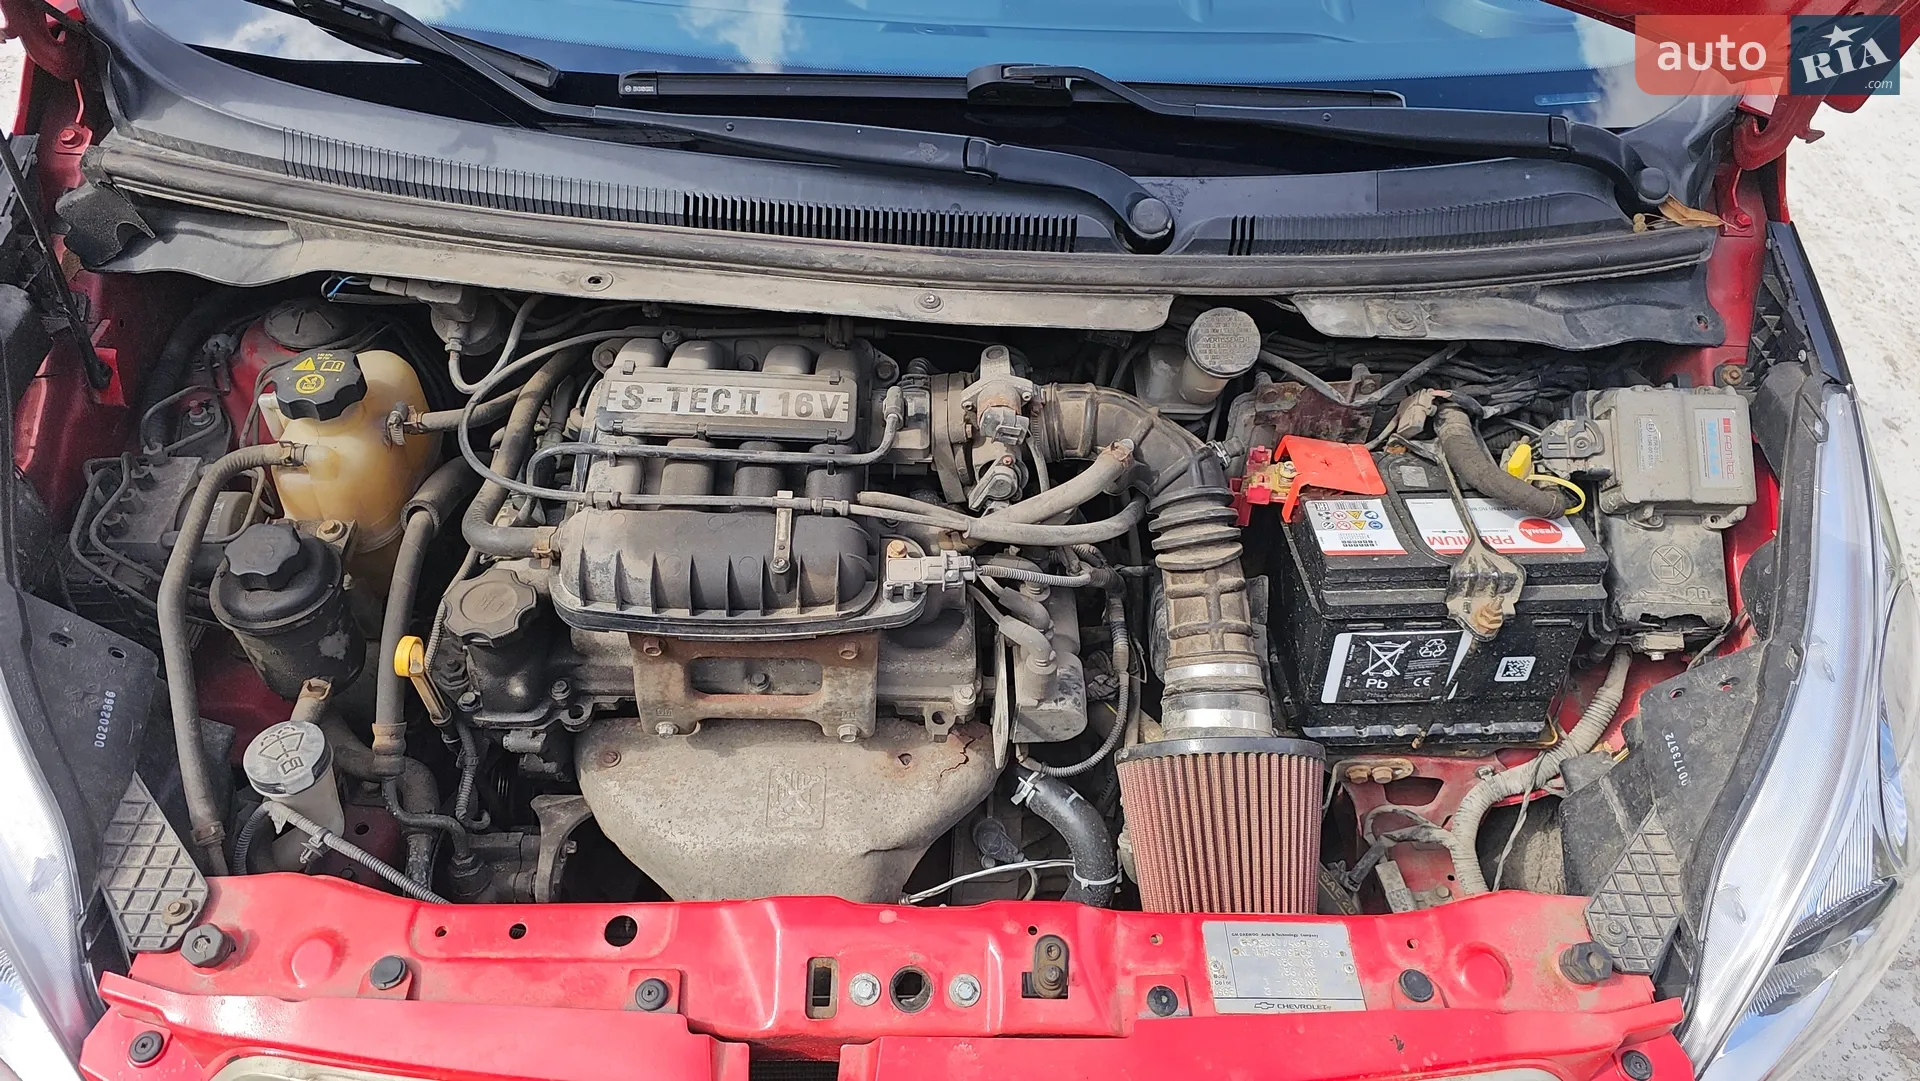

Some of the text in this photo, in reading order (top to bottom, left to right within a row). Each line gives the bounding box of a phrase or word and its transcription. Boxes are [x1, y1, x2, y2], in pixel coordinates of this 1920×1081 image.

[778, 391, 842, 419] 16V
[1365, 678, 1389, 689] Pb
[1413, 677, 1432, 687] CE
[94, 690, 116, 748] 00202366
[1664, 732, 1688, 786] 00173372
[1321, 871, 1345, 899] SAE
